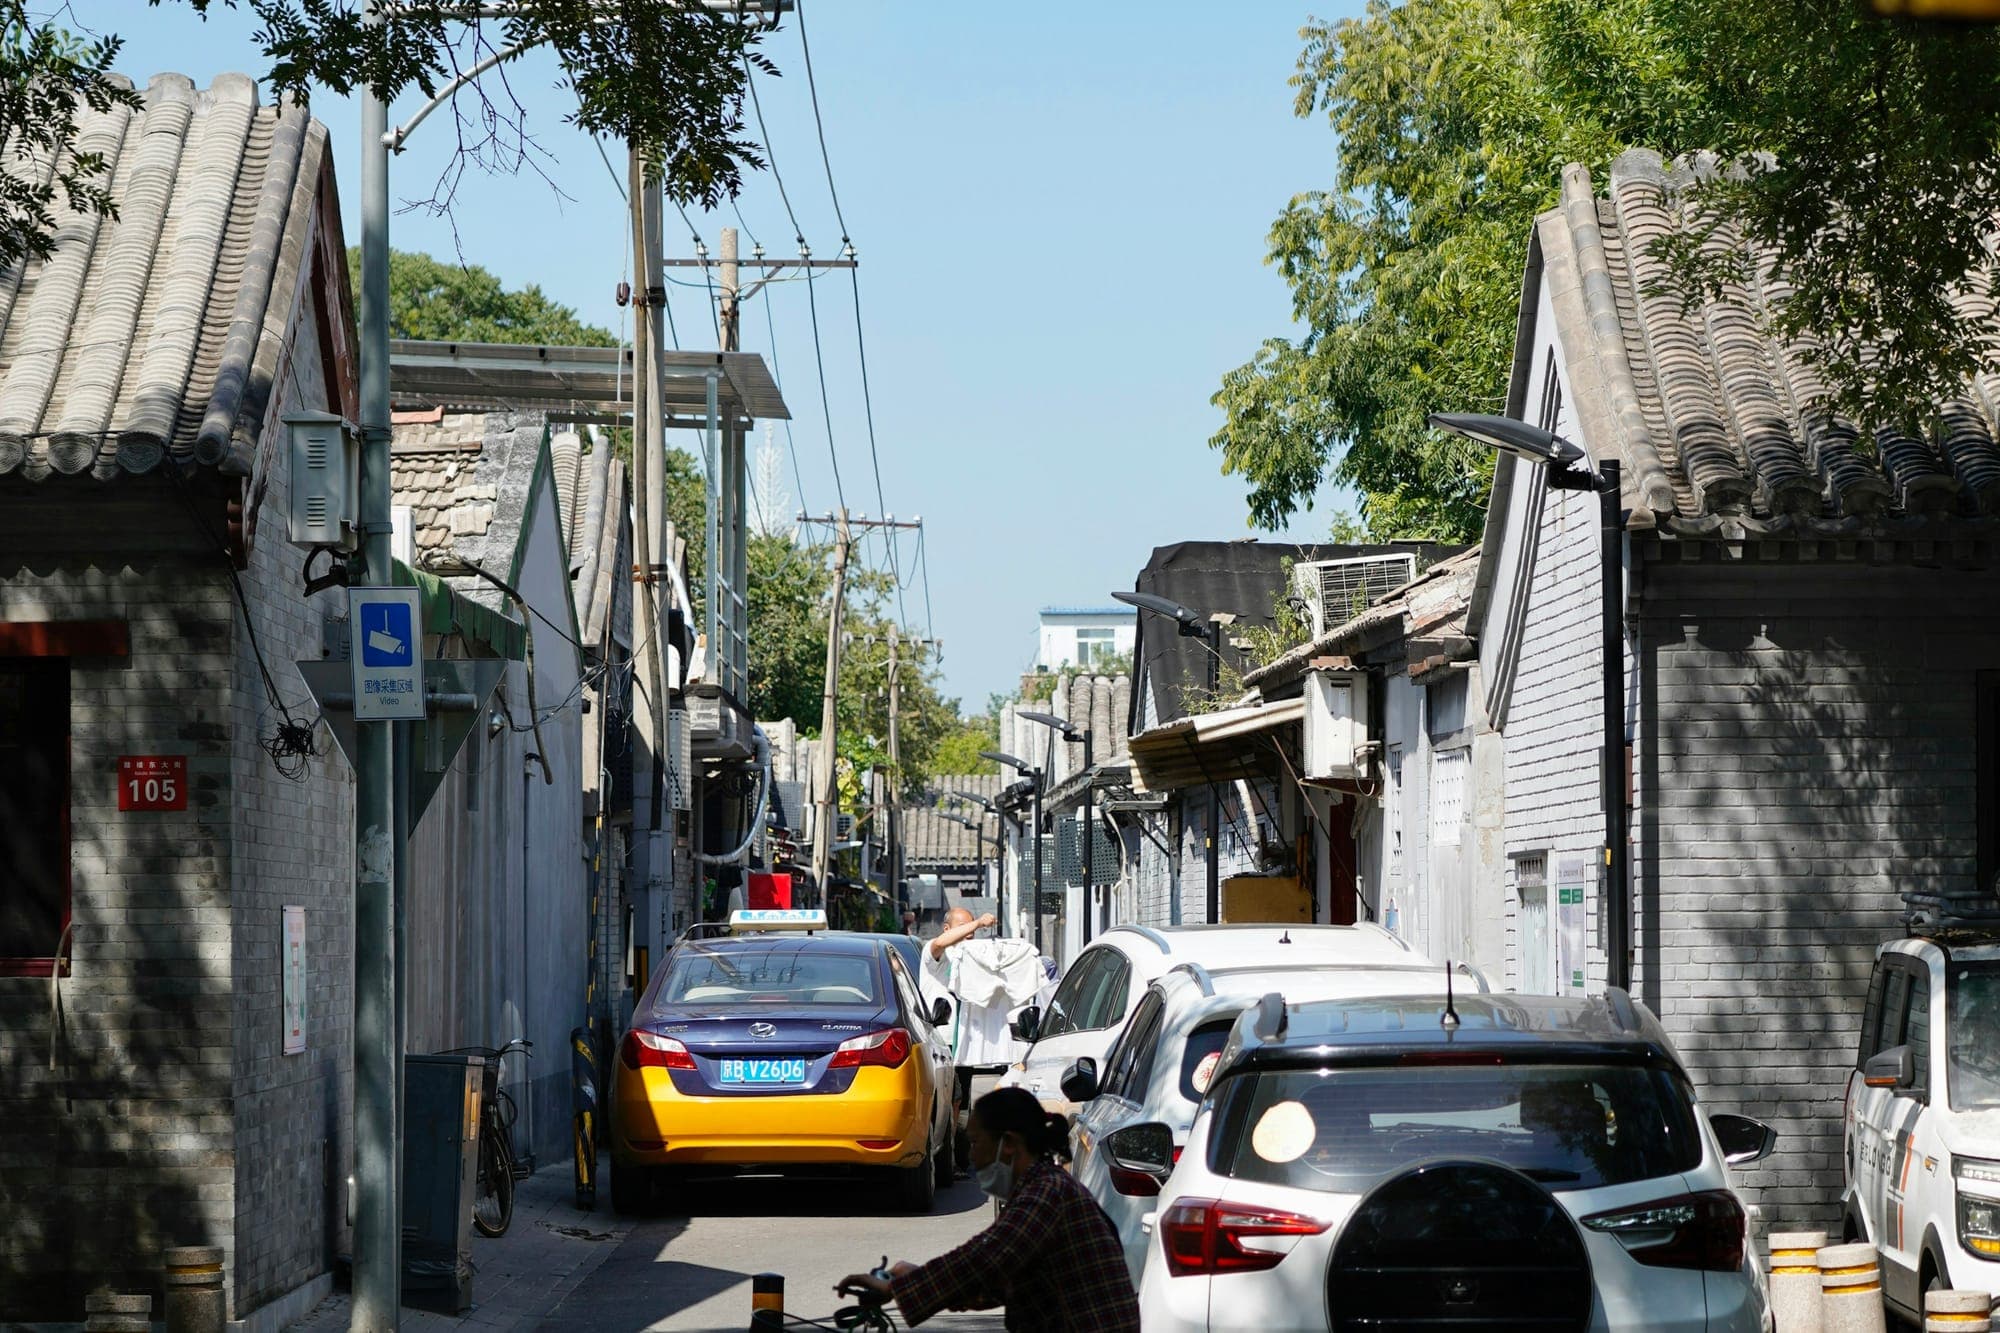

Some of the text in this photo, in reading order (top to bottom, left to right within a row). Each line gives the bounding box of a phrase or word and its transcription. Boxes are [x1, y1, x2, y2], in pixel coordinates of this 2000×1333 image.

[364, 678, 413, 694] 图像采集区域
[379, 696, 399, 705] Video
[128, 779, 176, 802] 105
